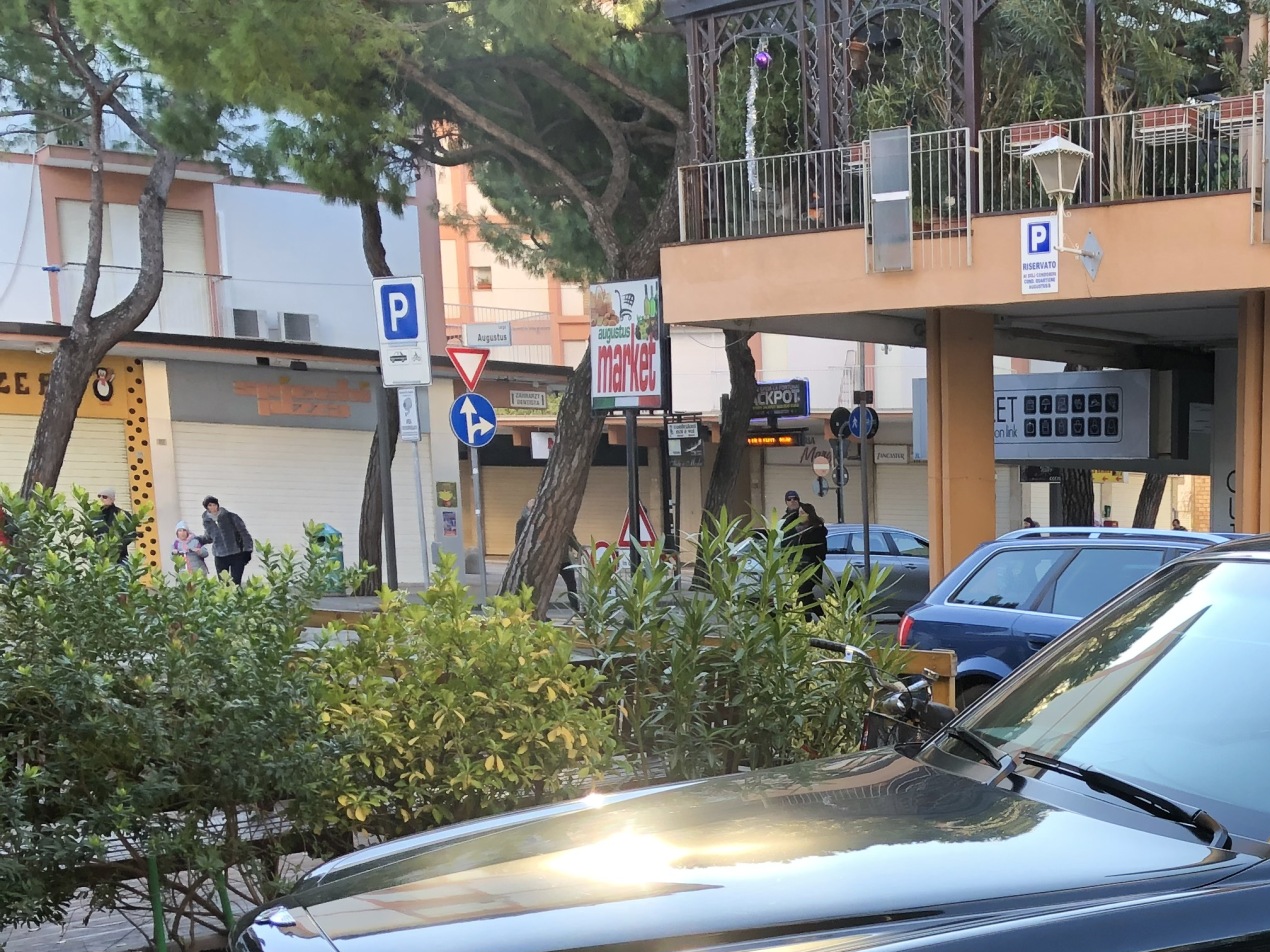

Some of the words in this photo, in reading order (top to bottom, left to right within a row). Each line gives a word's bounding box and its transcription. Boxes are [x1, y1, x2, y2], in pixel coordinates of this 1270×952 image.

[1031, 225, 1047, 251] P
[1023, 260, 1057, 271] RISERVATO
[388, 292, 409, 332] P
[477, 333, 508, 343] Augustus
[598, 324, 631, 344] augustus
[597, 323, 657, 393] market
[1006, 424, 1018, 438] link
